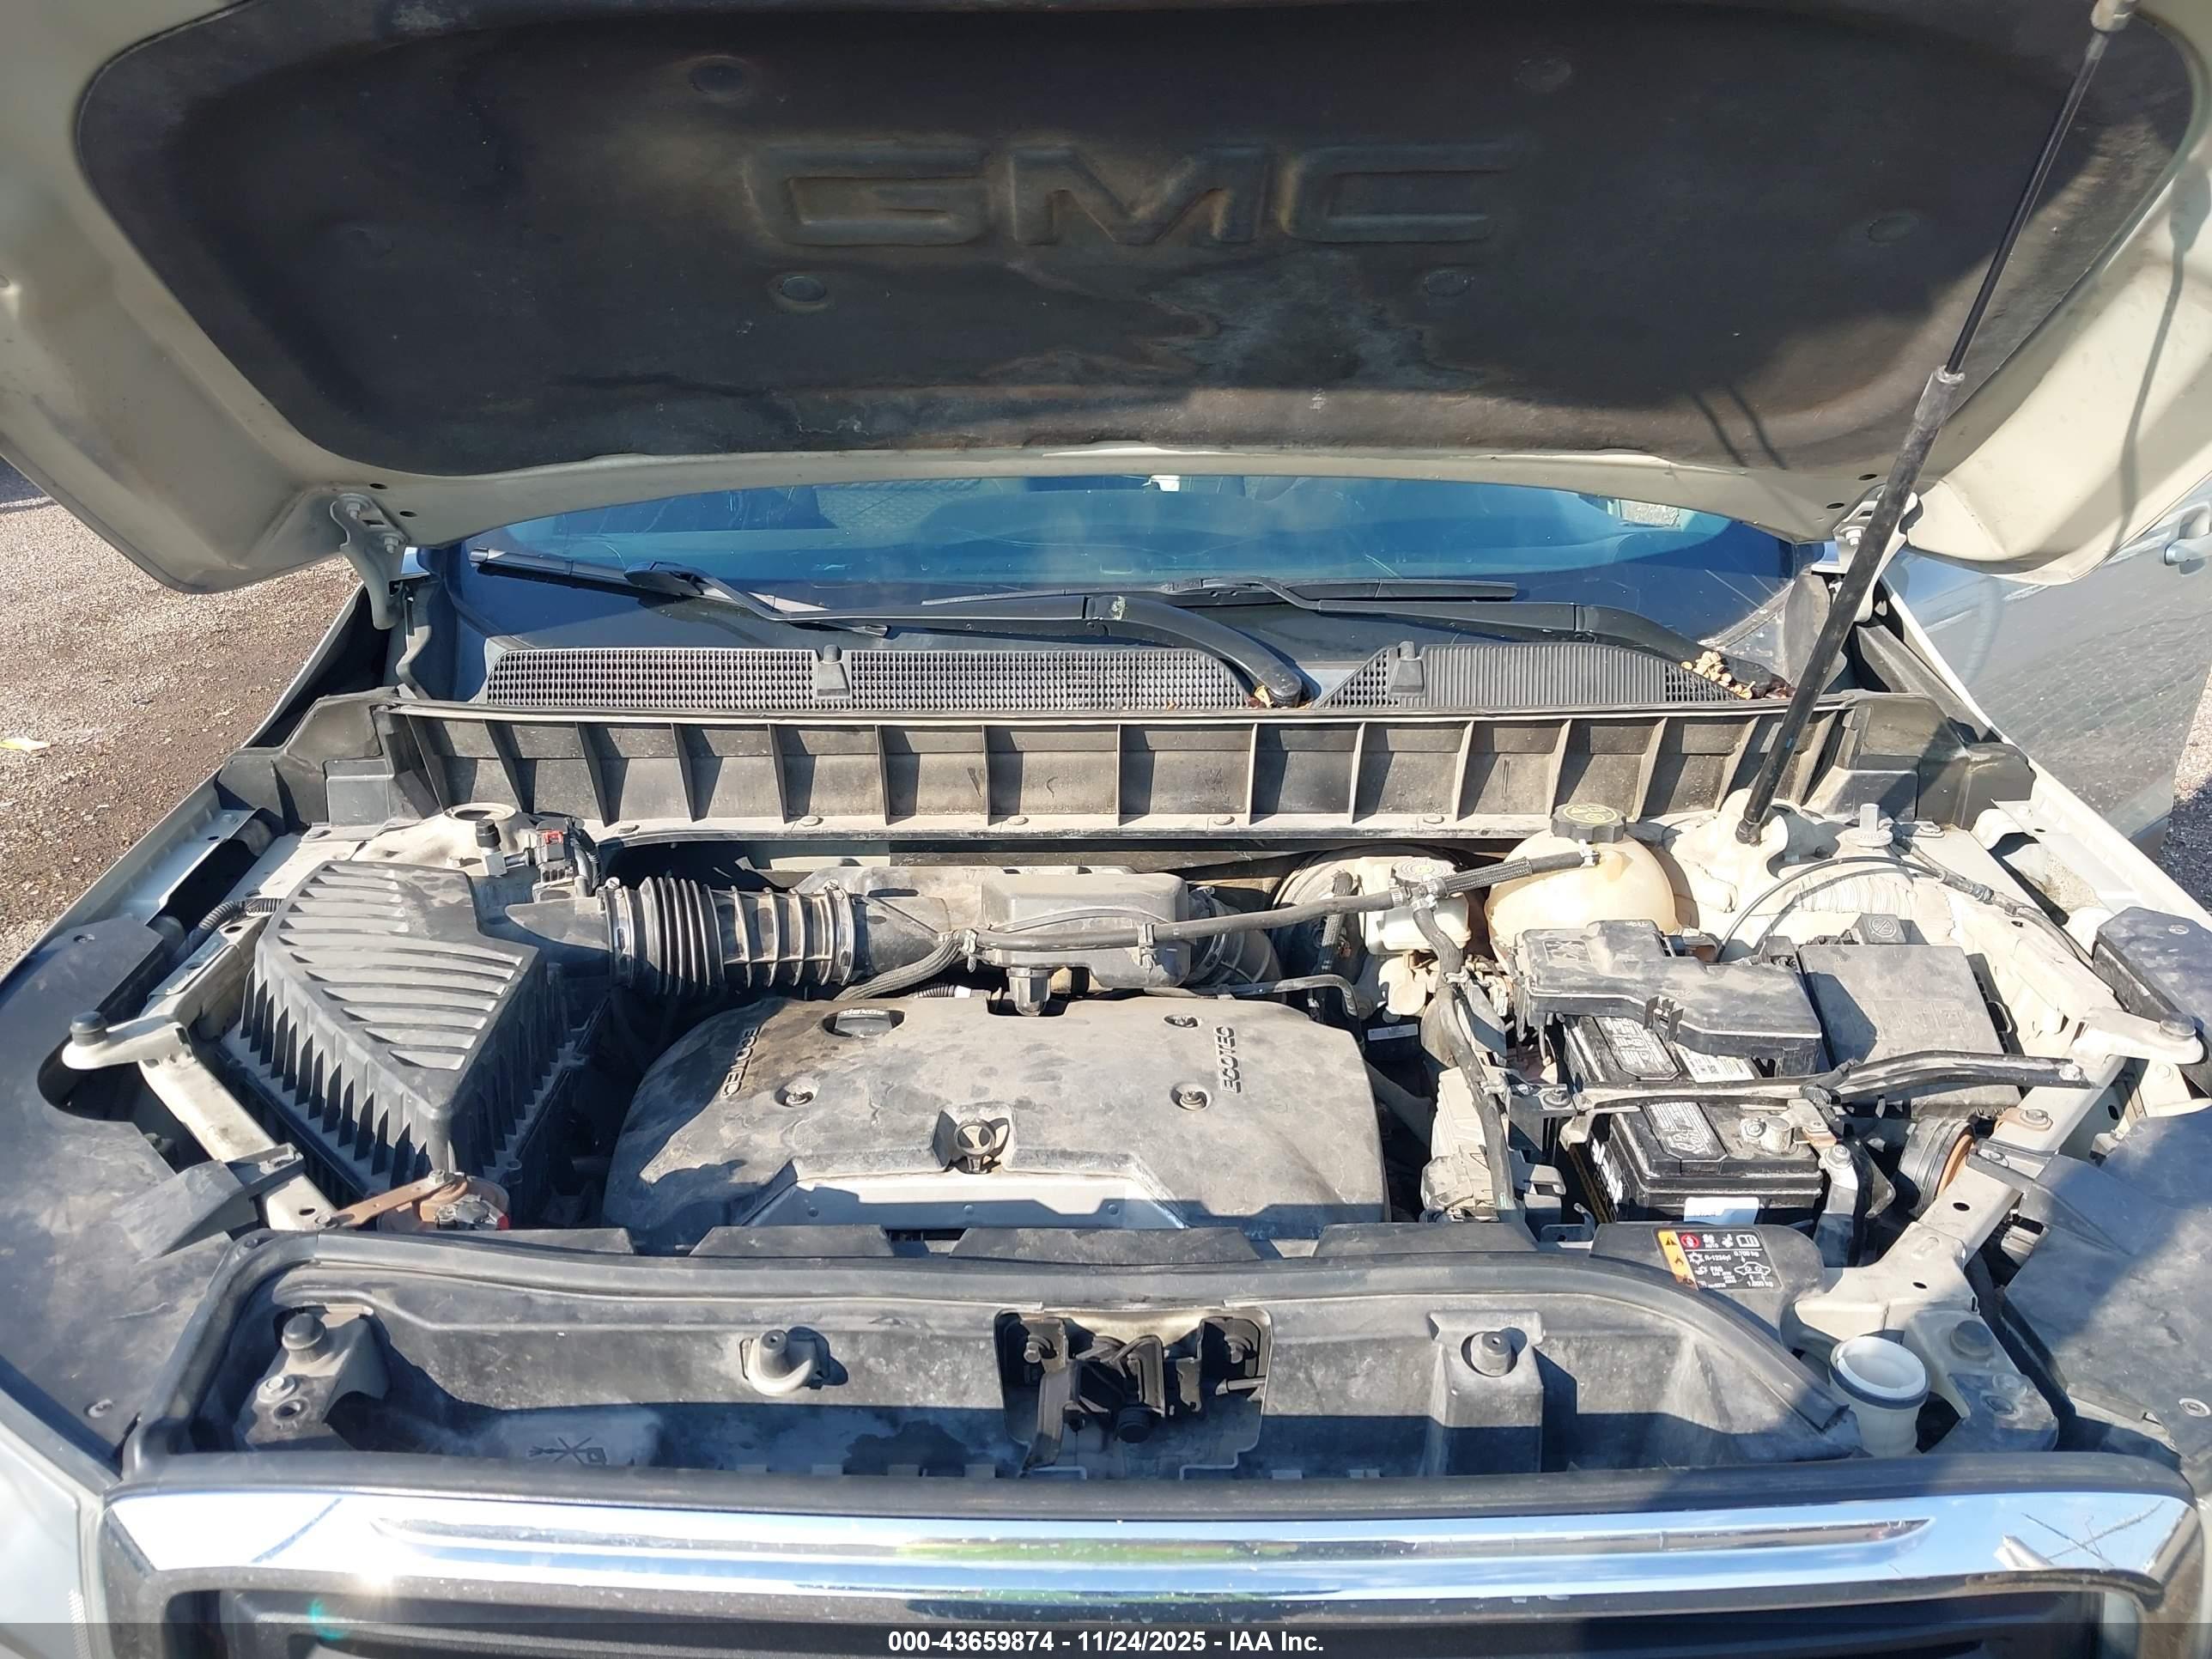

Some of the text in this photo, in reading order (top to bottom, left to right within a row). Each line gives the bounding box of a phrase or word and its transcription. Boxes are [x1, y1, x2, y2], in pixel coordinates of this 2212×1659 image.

[744, 143, 1514, 247] GMC
[720, 1026, 762, 1097] ECOTEC
[1215, 1025, 1242, 1094] ECOTEC
